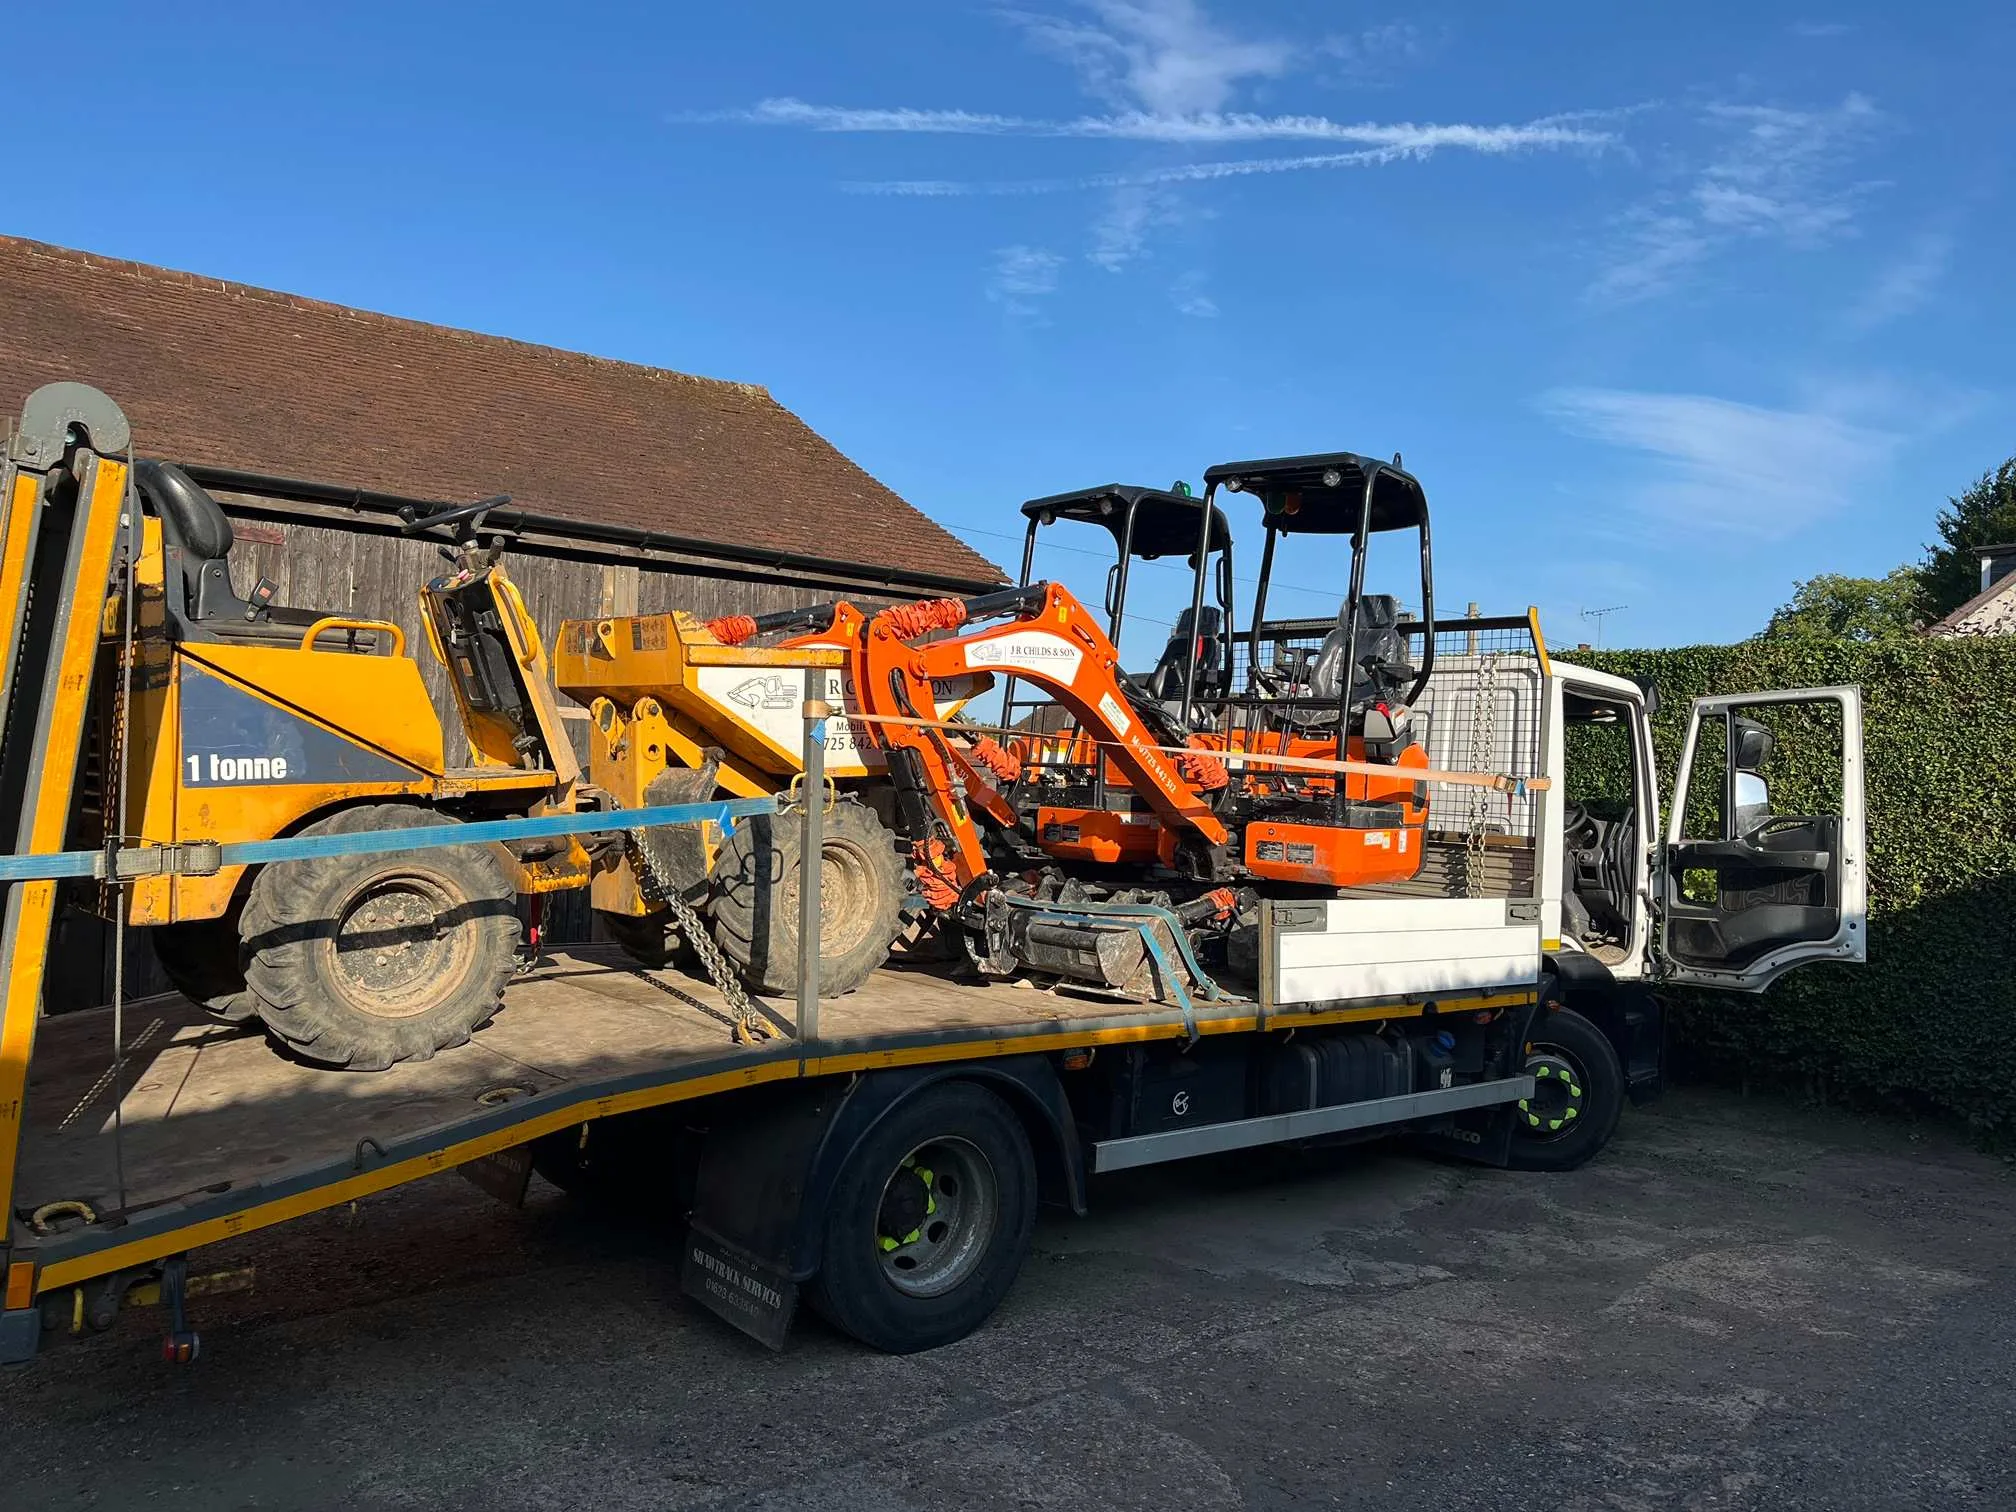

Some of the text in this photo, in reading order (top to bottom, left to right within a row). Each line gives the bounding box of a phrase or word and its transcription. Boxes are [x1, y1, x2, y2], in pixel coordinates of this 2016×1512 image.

[1023, 645, 1052, 657] CHILDS
[1060, 647, 1075, 657] SON
[829, 679, 840, 695] R
[931, 679, 953, 696] ON
[849, 736, 872, 751] 842
[186, 753, 287, 782] 1 tonne
[741, 1275, 781, 1309] SERVICES
